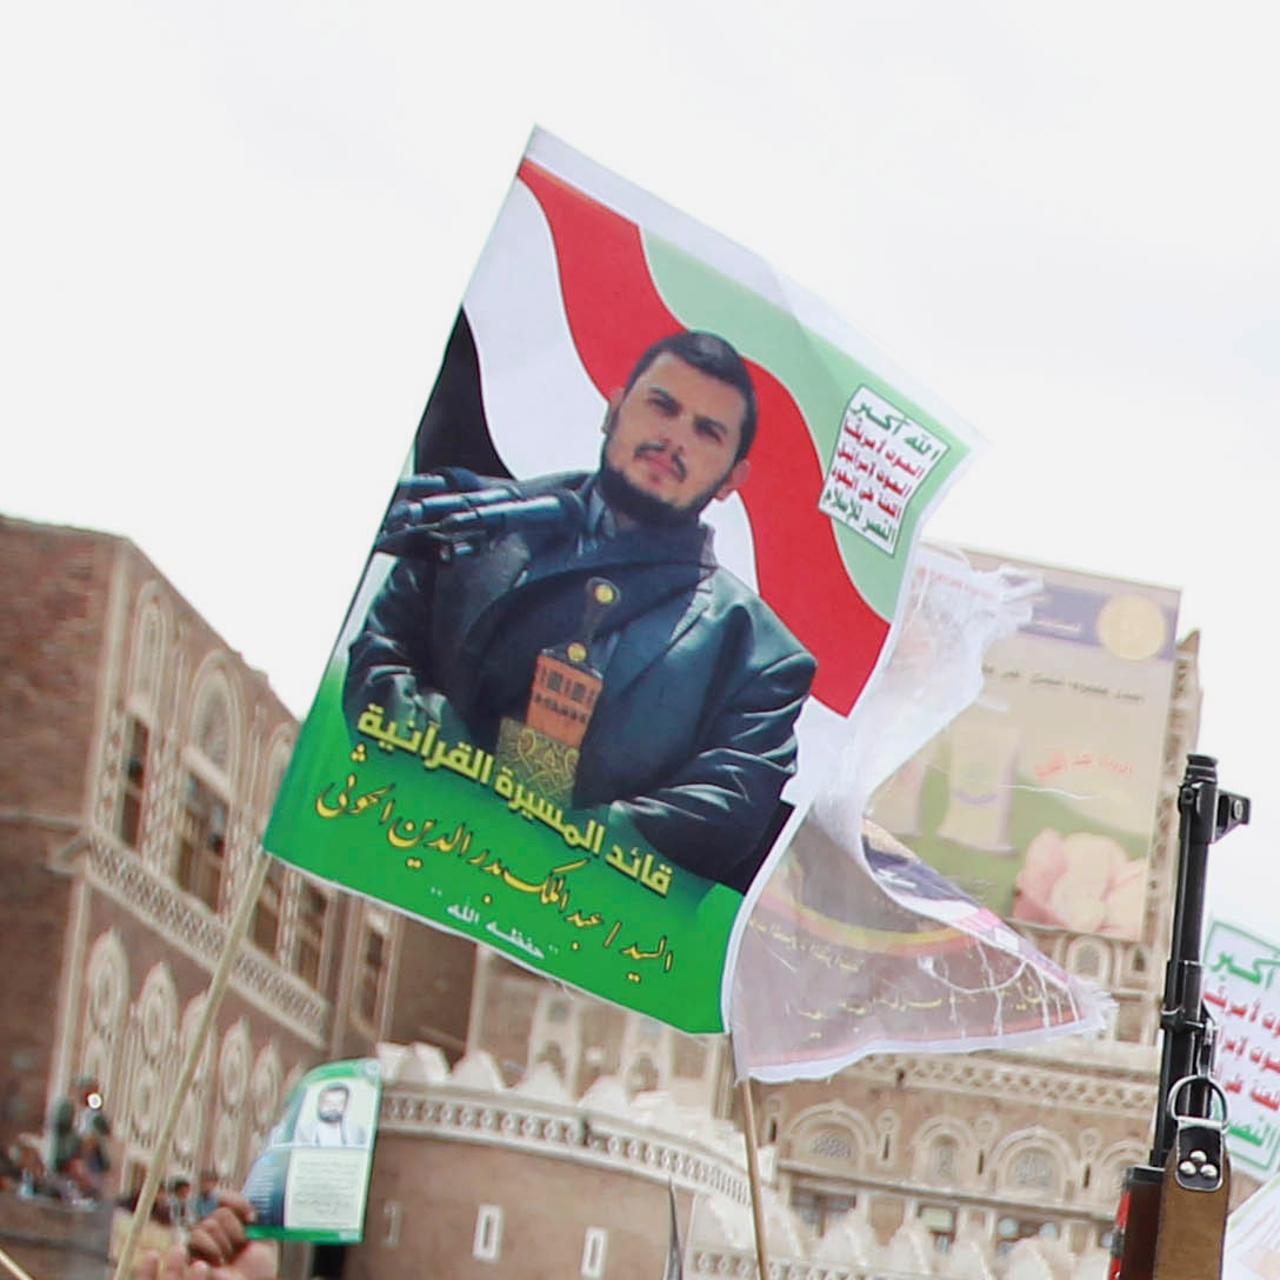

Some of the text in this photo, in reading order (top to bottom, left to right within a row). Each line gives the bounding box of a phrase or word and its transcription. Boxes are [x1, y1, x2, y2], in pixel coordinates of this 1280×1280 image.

[495, 767, 605, 855] المسيرة
[388, 819, 473, 870] الدين
[605, 845, 673, 897] قائد
[446, 897, 480, 925] الله
[620, 936, 673, 982] السيد
